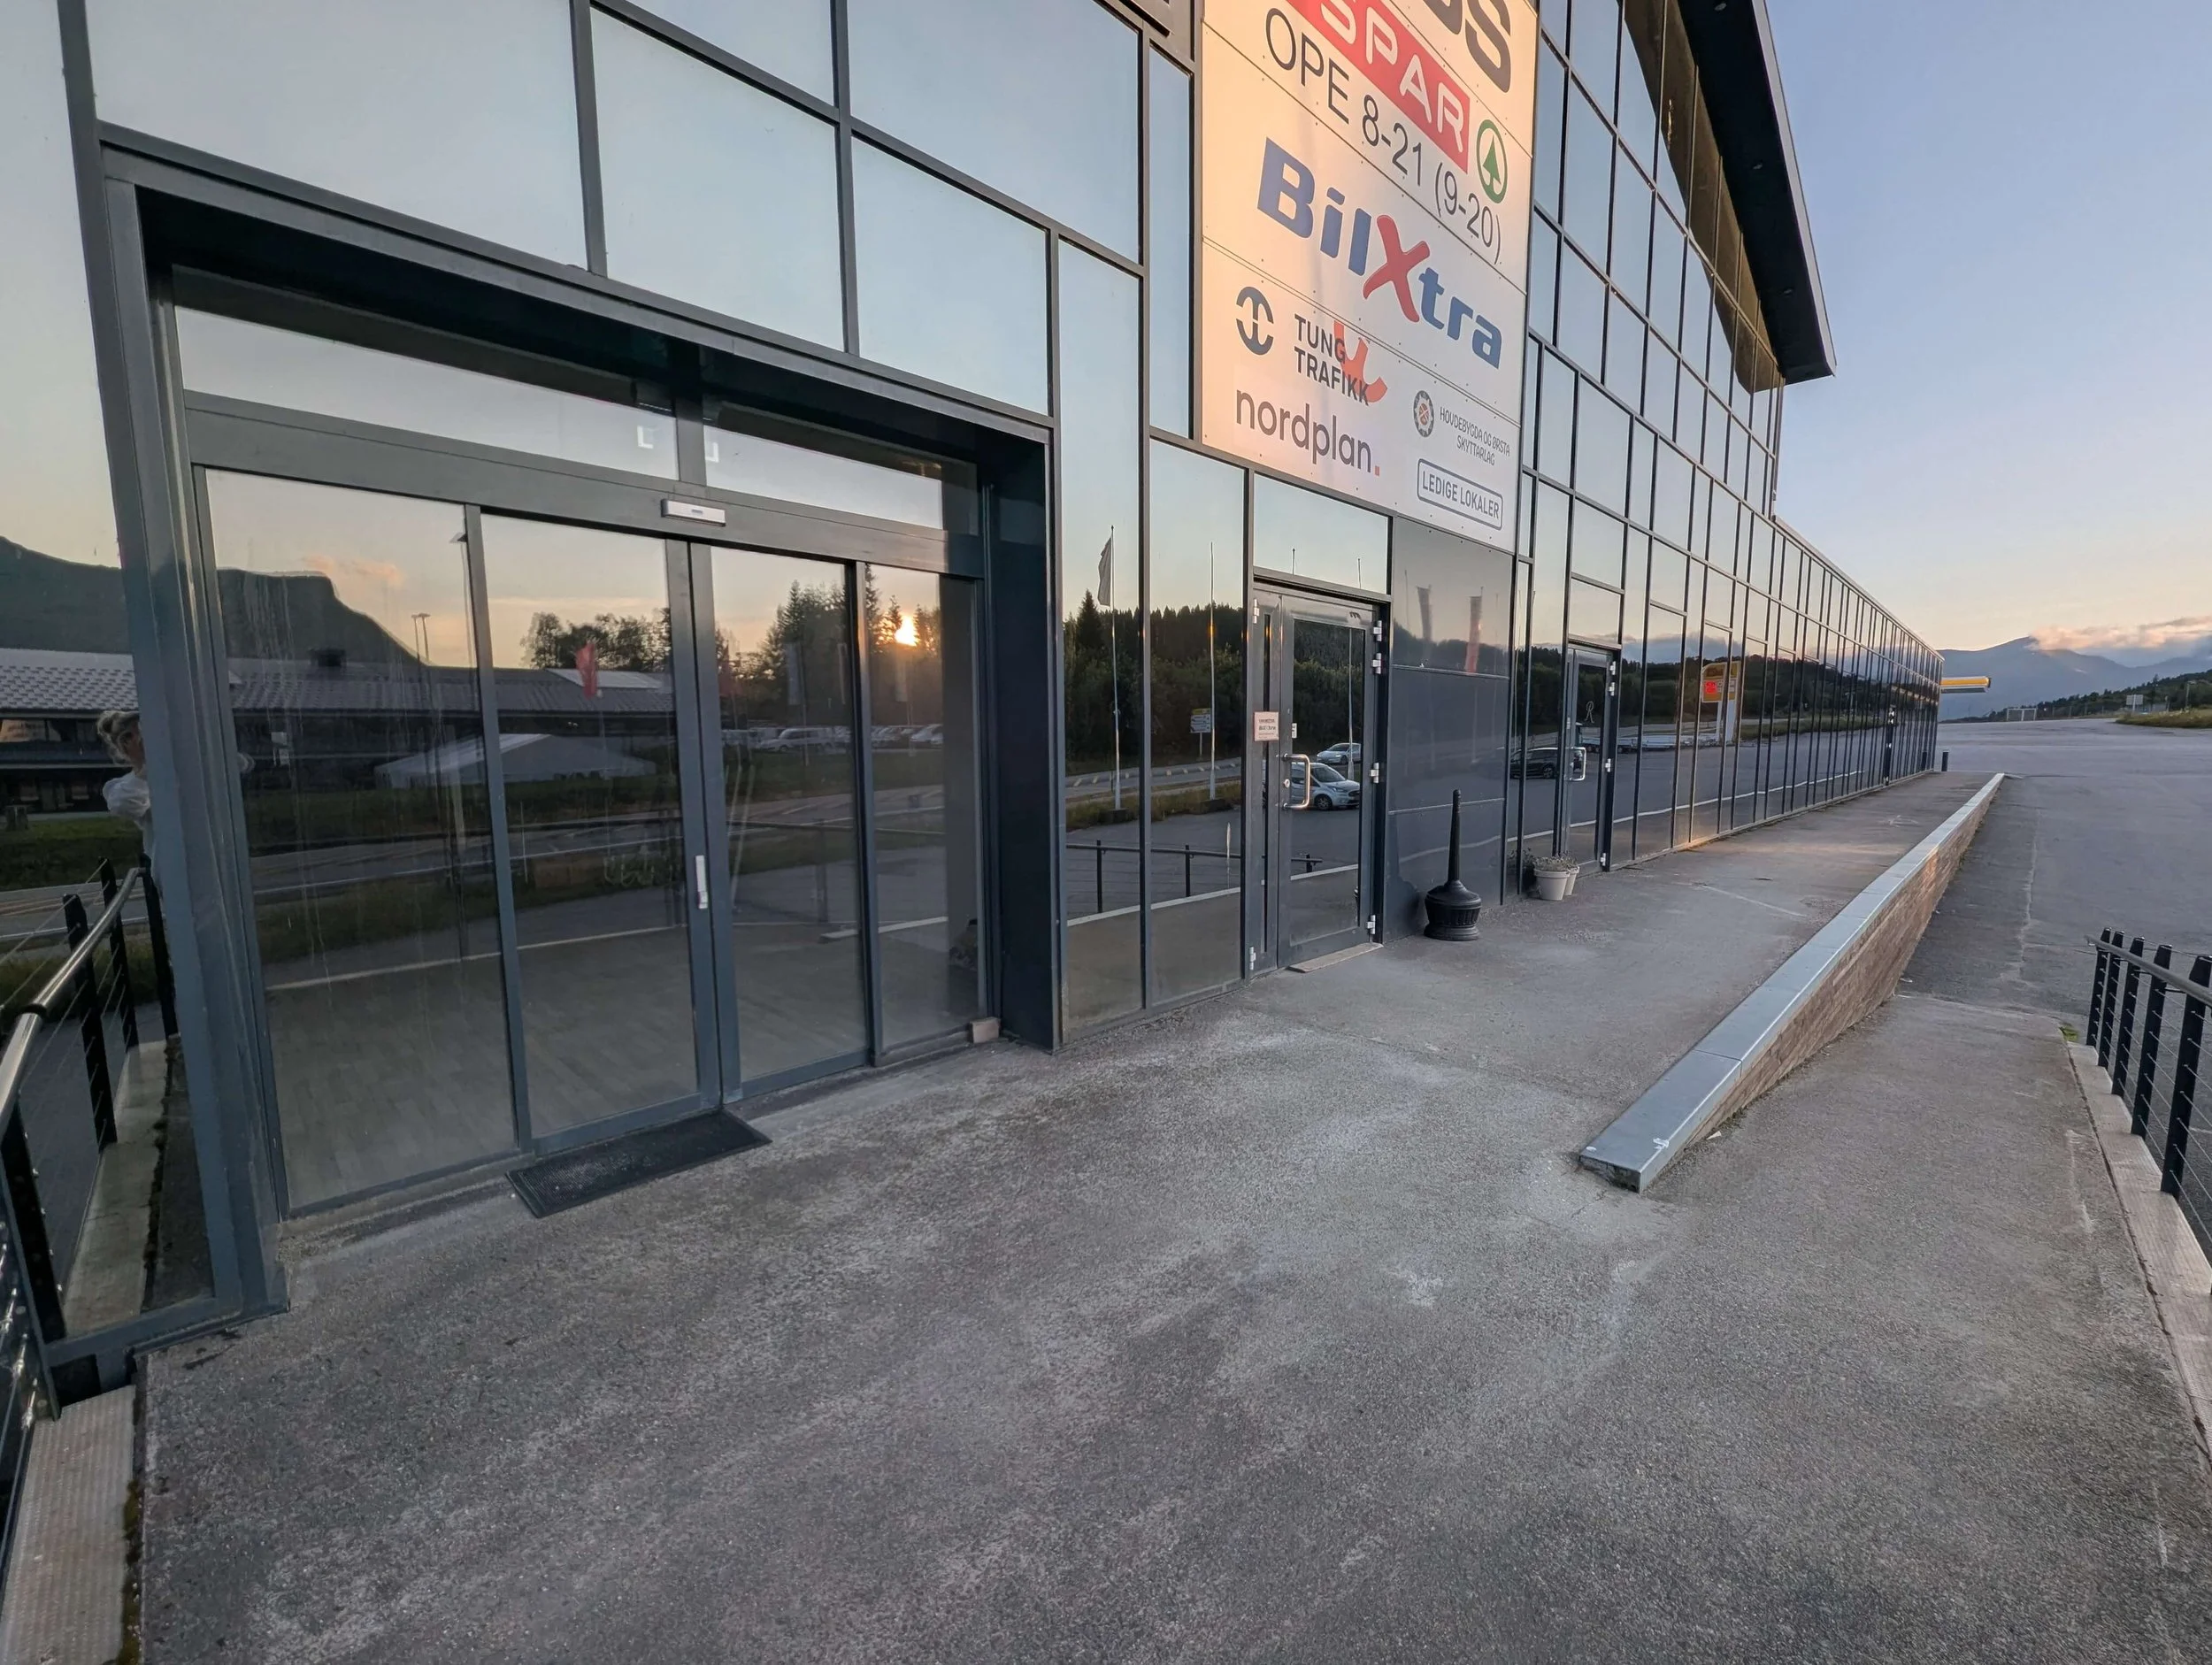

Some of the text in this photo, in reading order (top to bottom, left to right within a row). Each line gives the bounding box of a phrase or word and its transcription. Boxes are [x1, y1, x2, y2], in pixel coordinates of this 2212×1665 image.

[1419, 0, 1511, 93] S
[1265, 7, 1501, 265] OPE 8-21 (9-20)
[1256, 136, 1502, 370] BilXtra
[1294, 313, 1347, 364] TUNG
[1294, 346, 1370, 406] TRAFIKK
[1456, 434, 1495, 465] SKYTTARLAG
[1483, 431, 1492, 447] OG
[1422, 470, 1500, 519] LEDIGE LOKALER
